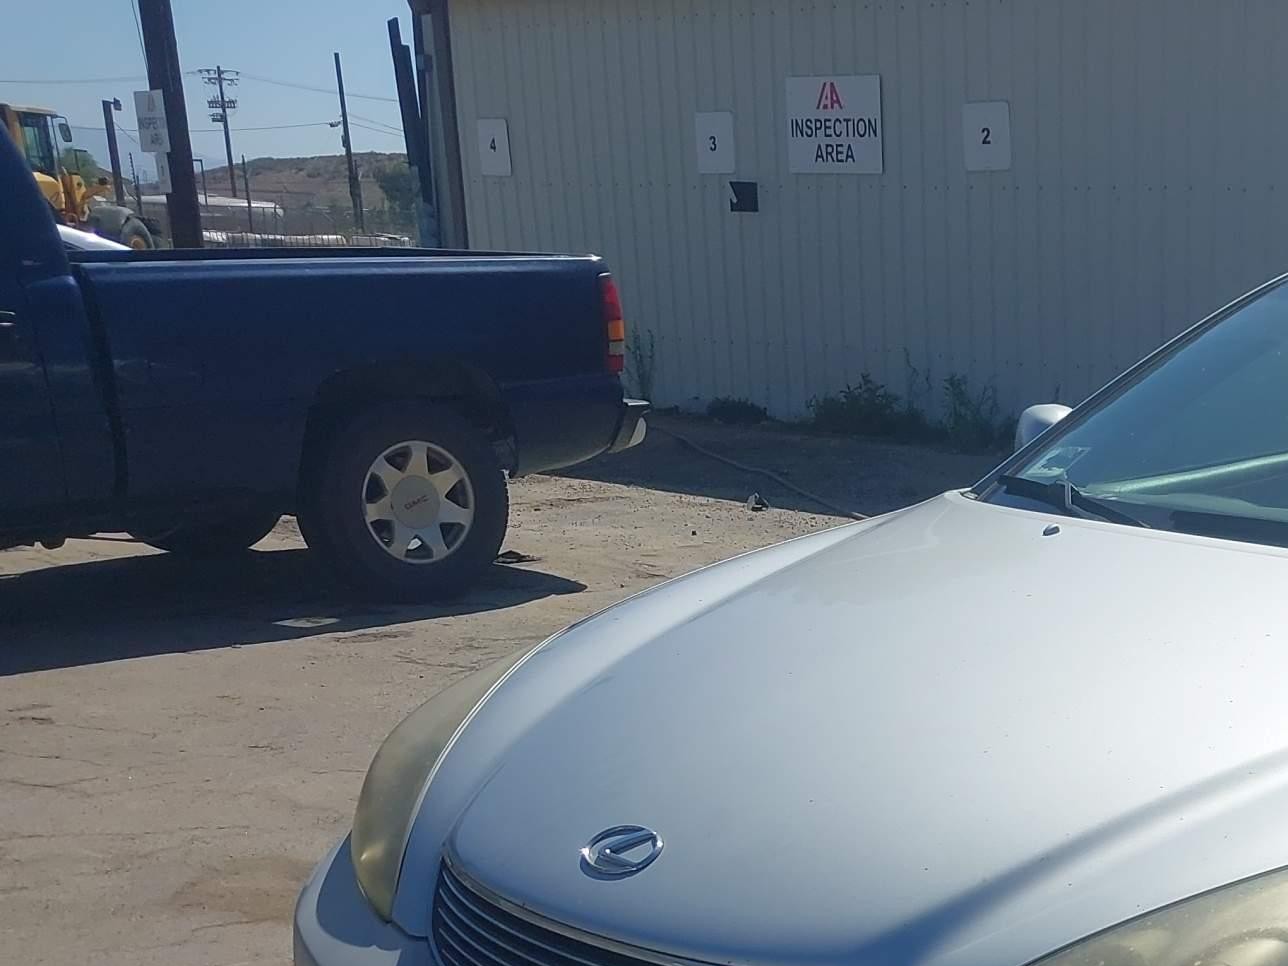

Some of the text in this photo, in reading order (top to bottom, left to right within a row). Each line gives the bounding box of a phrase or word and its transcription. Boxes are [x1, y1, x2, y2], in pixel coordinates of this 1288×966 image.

[791, 118, 878, 138] INSPECTION
[981, 127, 992, 145] 2
[489, 137, 497, 153] 4
[709, 135, 717, 152] 3
[815, 143, 856, 163] AREA
